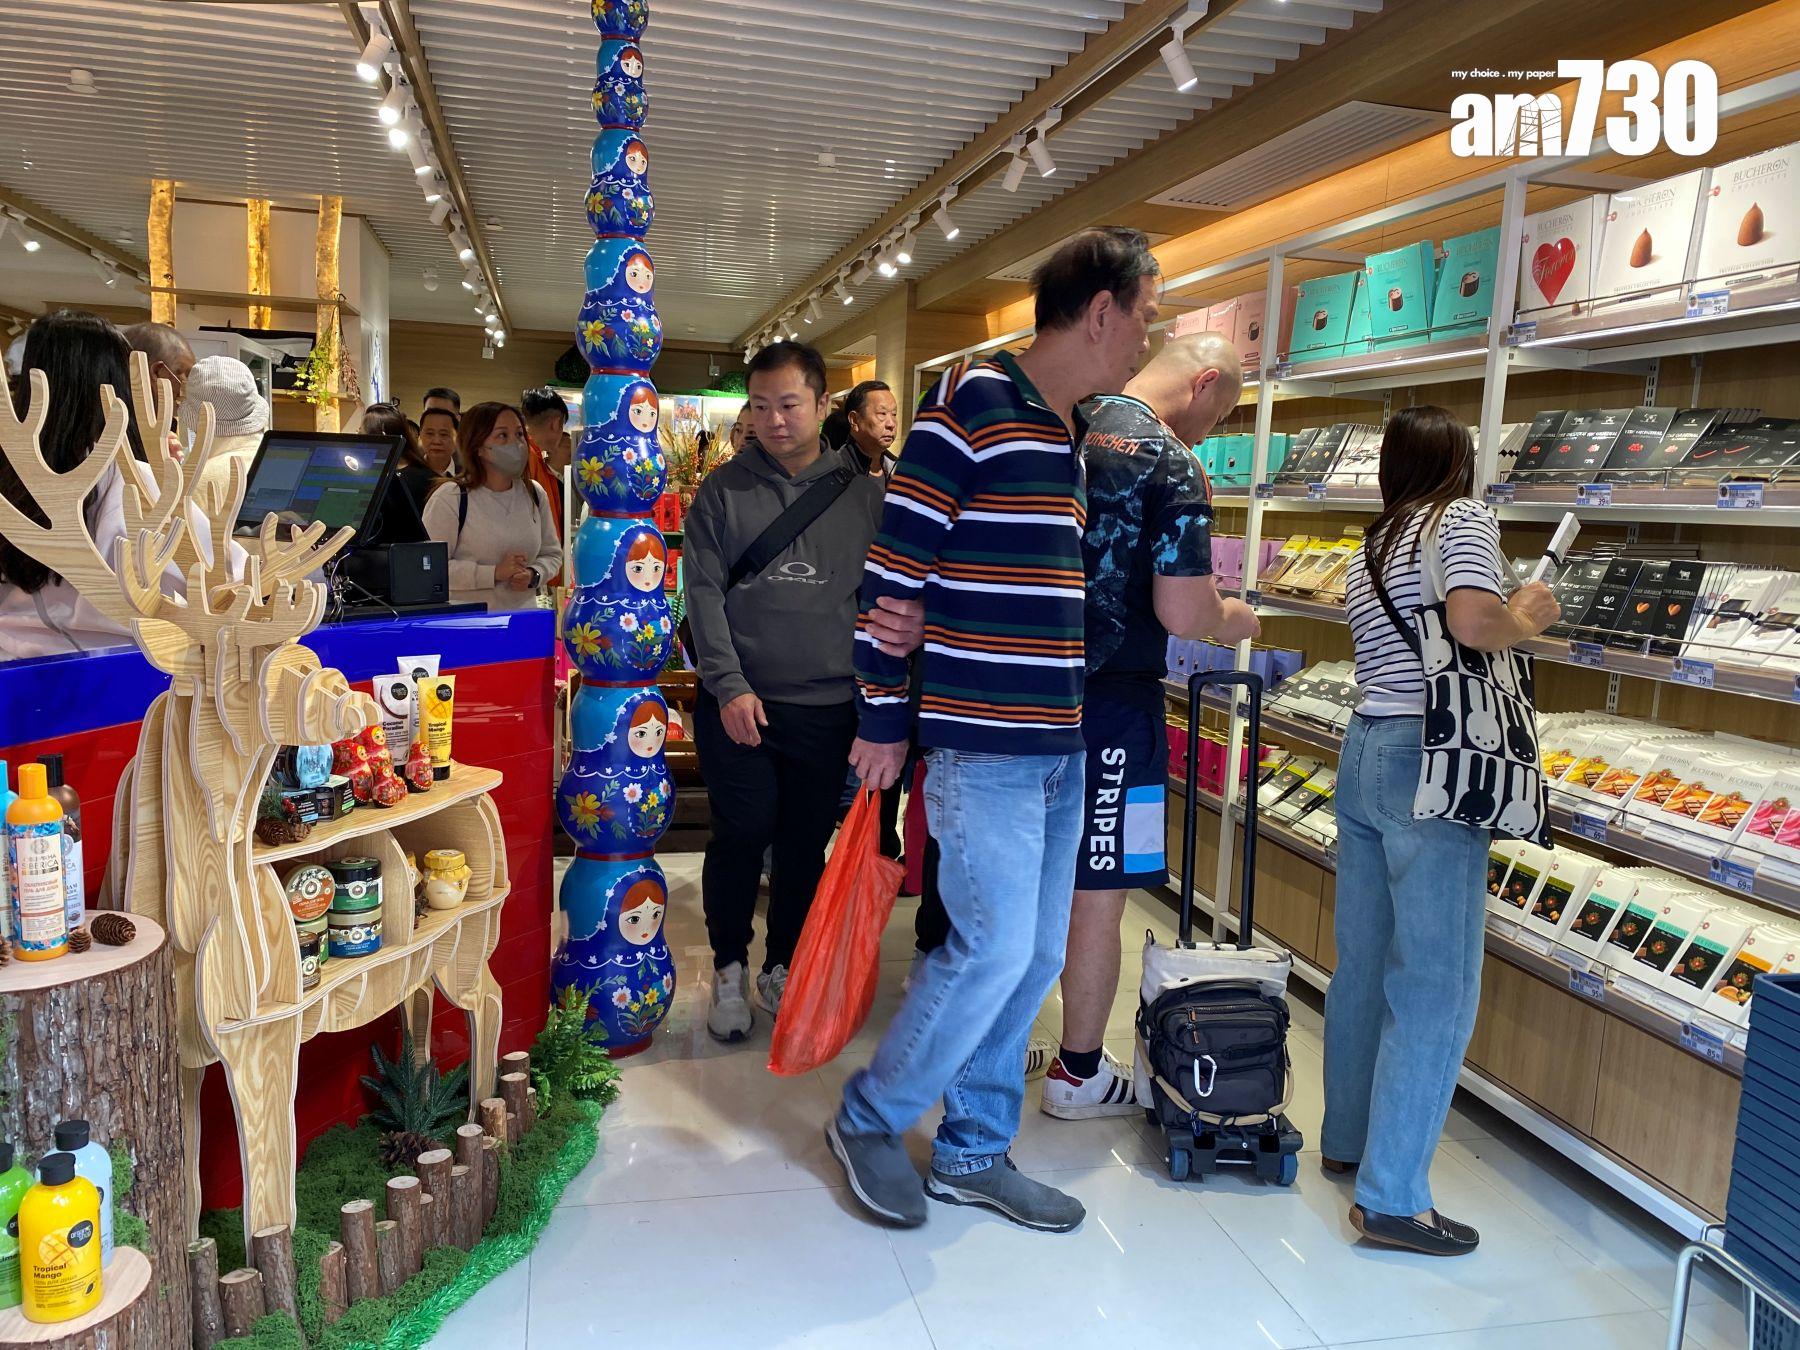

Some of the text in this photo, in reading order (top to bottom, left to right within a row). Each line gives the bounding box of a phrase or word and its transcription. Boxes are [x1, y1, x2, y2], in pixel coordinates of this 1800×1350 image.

[1089, 747, 1126, 871] STRIPES
[33, 1262, 67, 1273] Tropical
[33, 1272, 62, 1280] Mango
